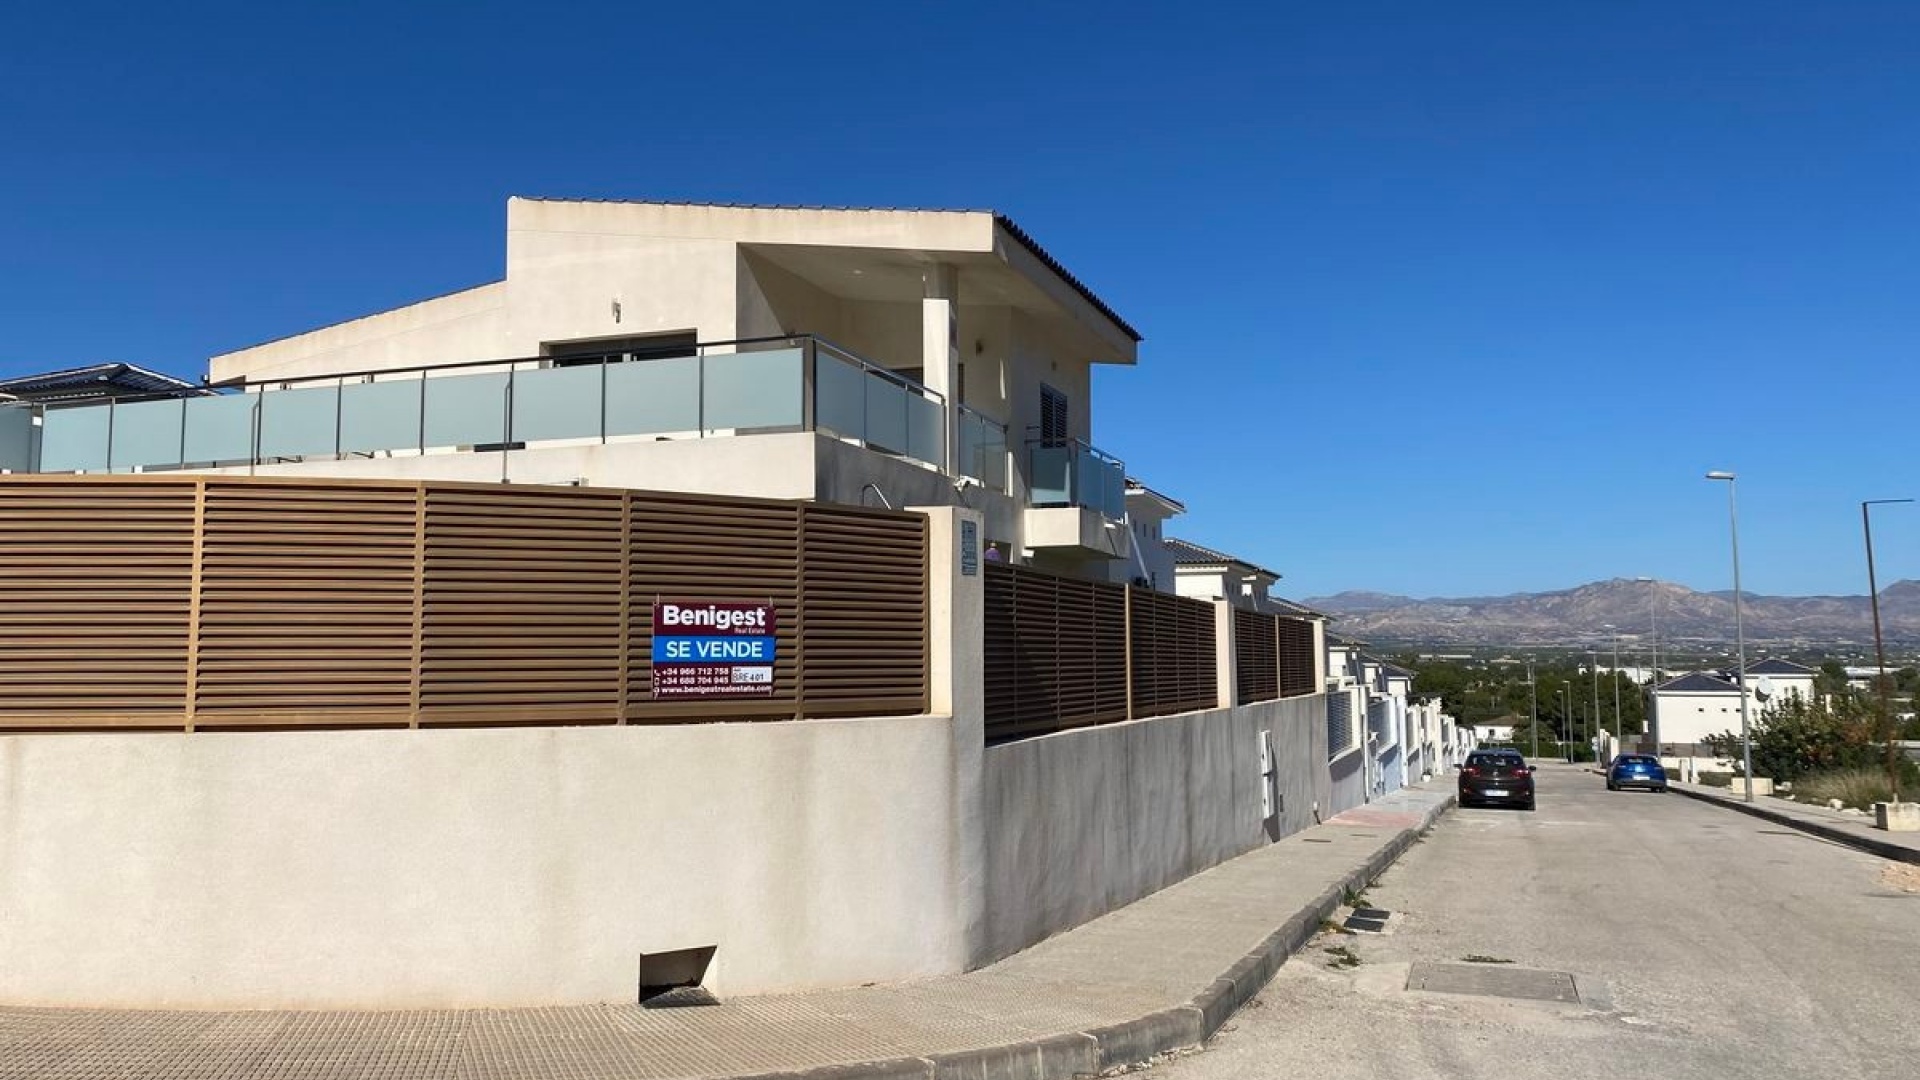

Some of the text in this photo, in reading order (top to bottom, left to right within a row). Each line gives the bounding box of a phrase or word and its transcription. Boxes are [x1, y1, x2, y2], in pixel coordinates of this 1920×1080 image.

[663, 605, 766, 629] Benigest
[666, 640, 763, 658] SE VENDE
[661, 667, 678, 675] +34
[697, 667, 713, 675] 712
